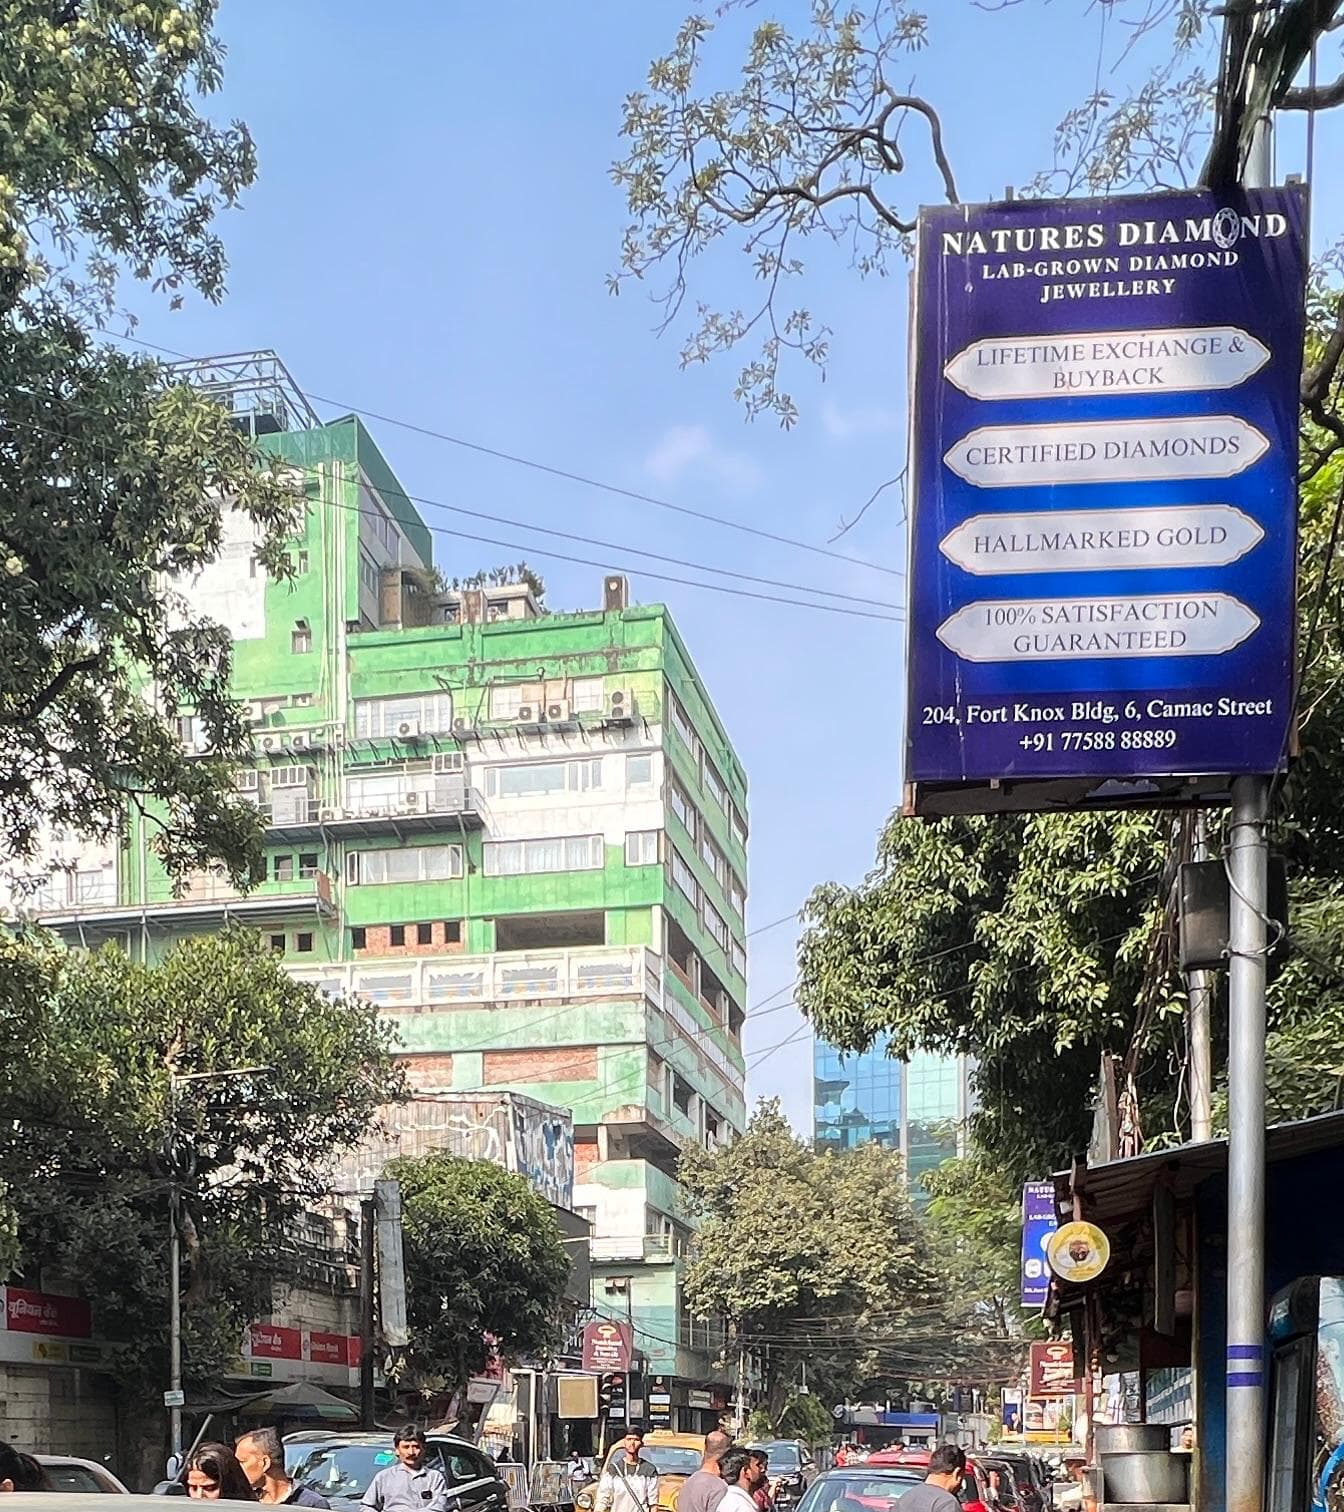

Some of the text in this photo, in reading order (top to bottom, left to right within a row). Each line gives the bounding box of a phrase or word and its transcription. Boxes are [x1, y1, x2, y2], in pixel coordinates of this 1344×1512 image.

[942, 207, 1288, 256] NATURES DIAMOND
[982, 251, 1240, 280] LAB-GROWN DIAMOND
[1039, 279, 1177, 304] JEWELLERY
[977, 336, 1247, 367] LIFETIME EXCHANGE &
[1053, 367, 1166, 390] BUYBACK
[965, 436, 1241, 467] CERTIFIED DIAMONDS
[973, 525, 1229, 554] HALLMARKED GOLD
[984, 600, 1220, 626] 100% SATISFACTION
[1013, 629, 1187, 654] GUARANTEED
[922, 697, 1274, 726] 204, Fort Knox Bldg, 6, Camac Street
[1018, 729, 1177, 752] +91 77588 88889
